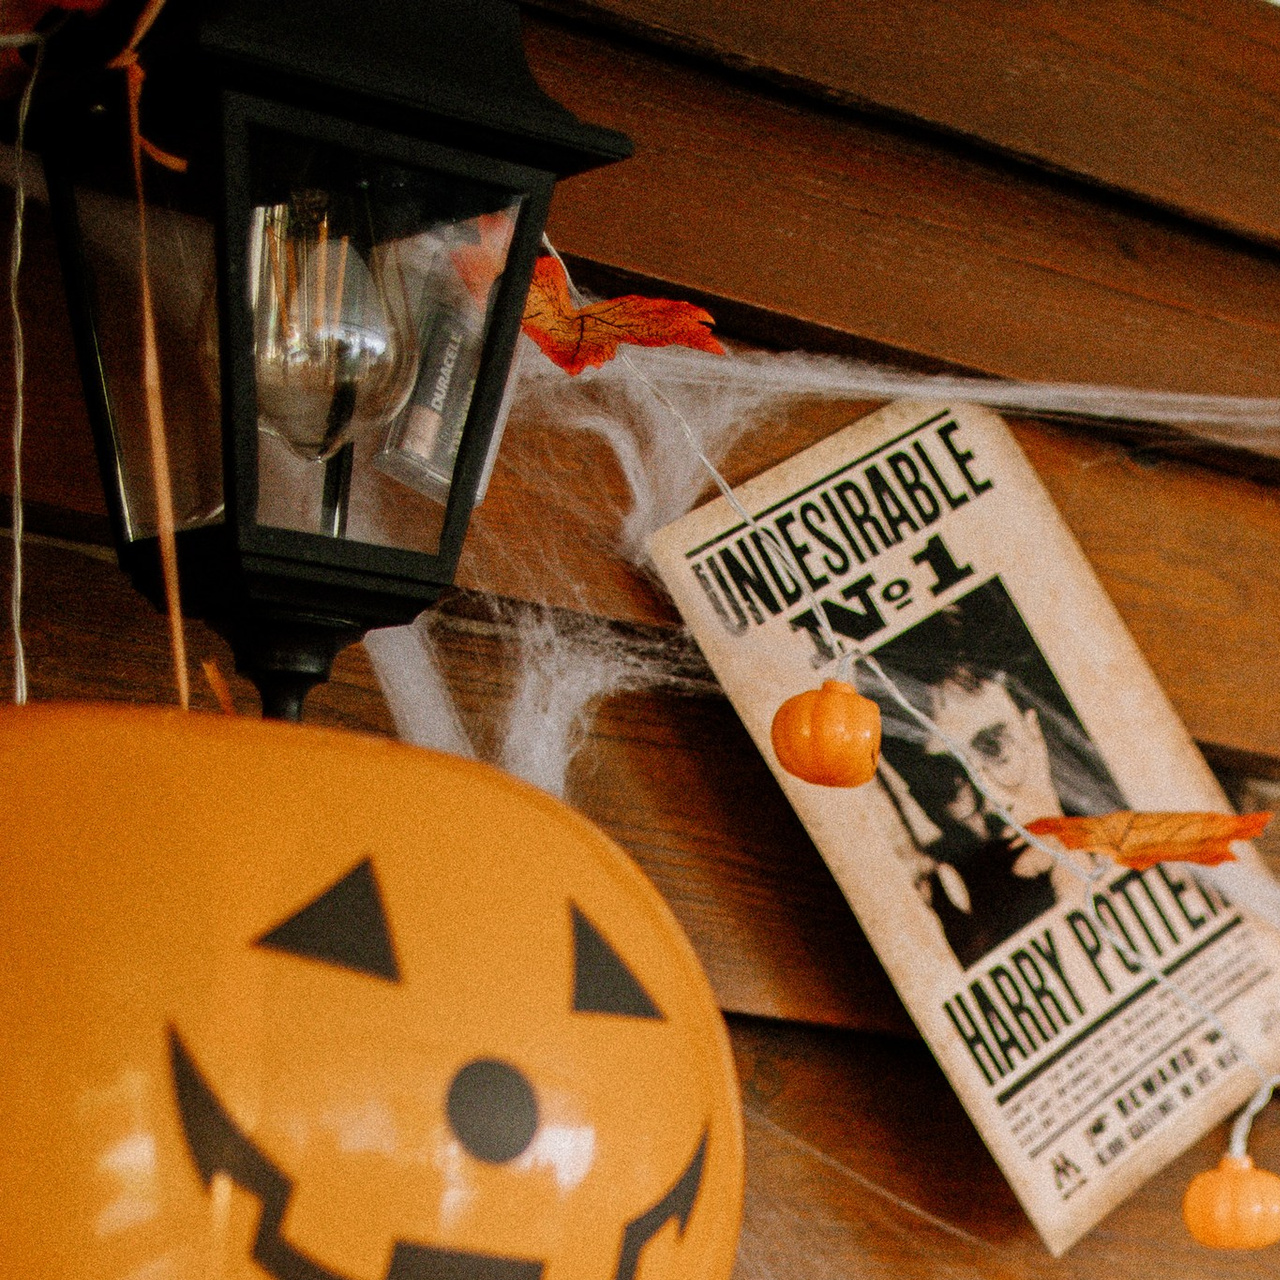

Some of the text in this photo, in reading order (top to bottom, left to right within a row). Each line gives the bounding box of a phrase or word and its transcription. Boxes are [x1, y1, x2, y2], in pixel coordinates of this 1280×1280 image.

[431, 330, 462, 412] DURACELL
[692, 420, 992, 635] UNDESIRABLE
[943, 929, 1085, 1086] HARRY
[1117, 1048, 1196, 1118] REWARD
